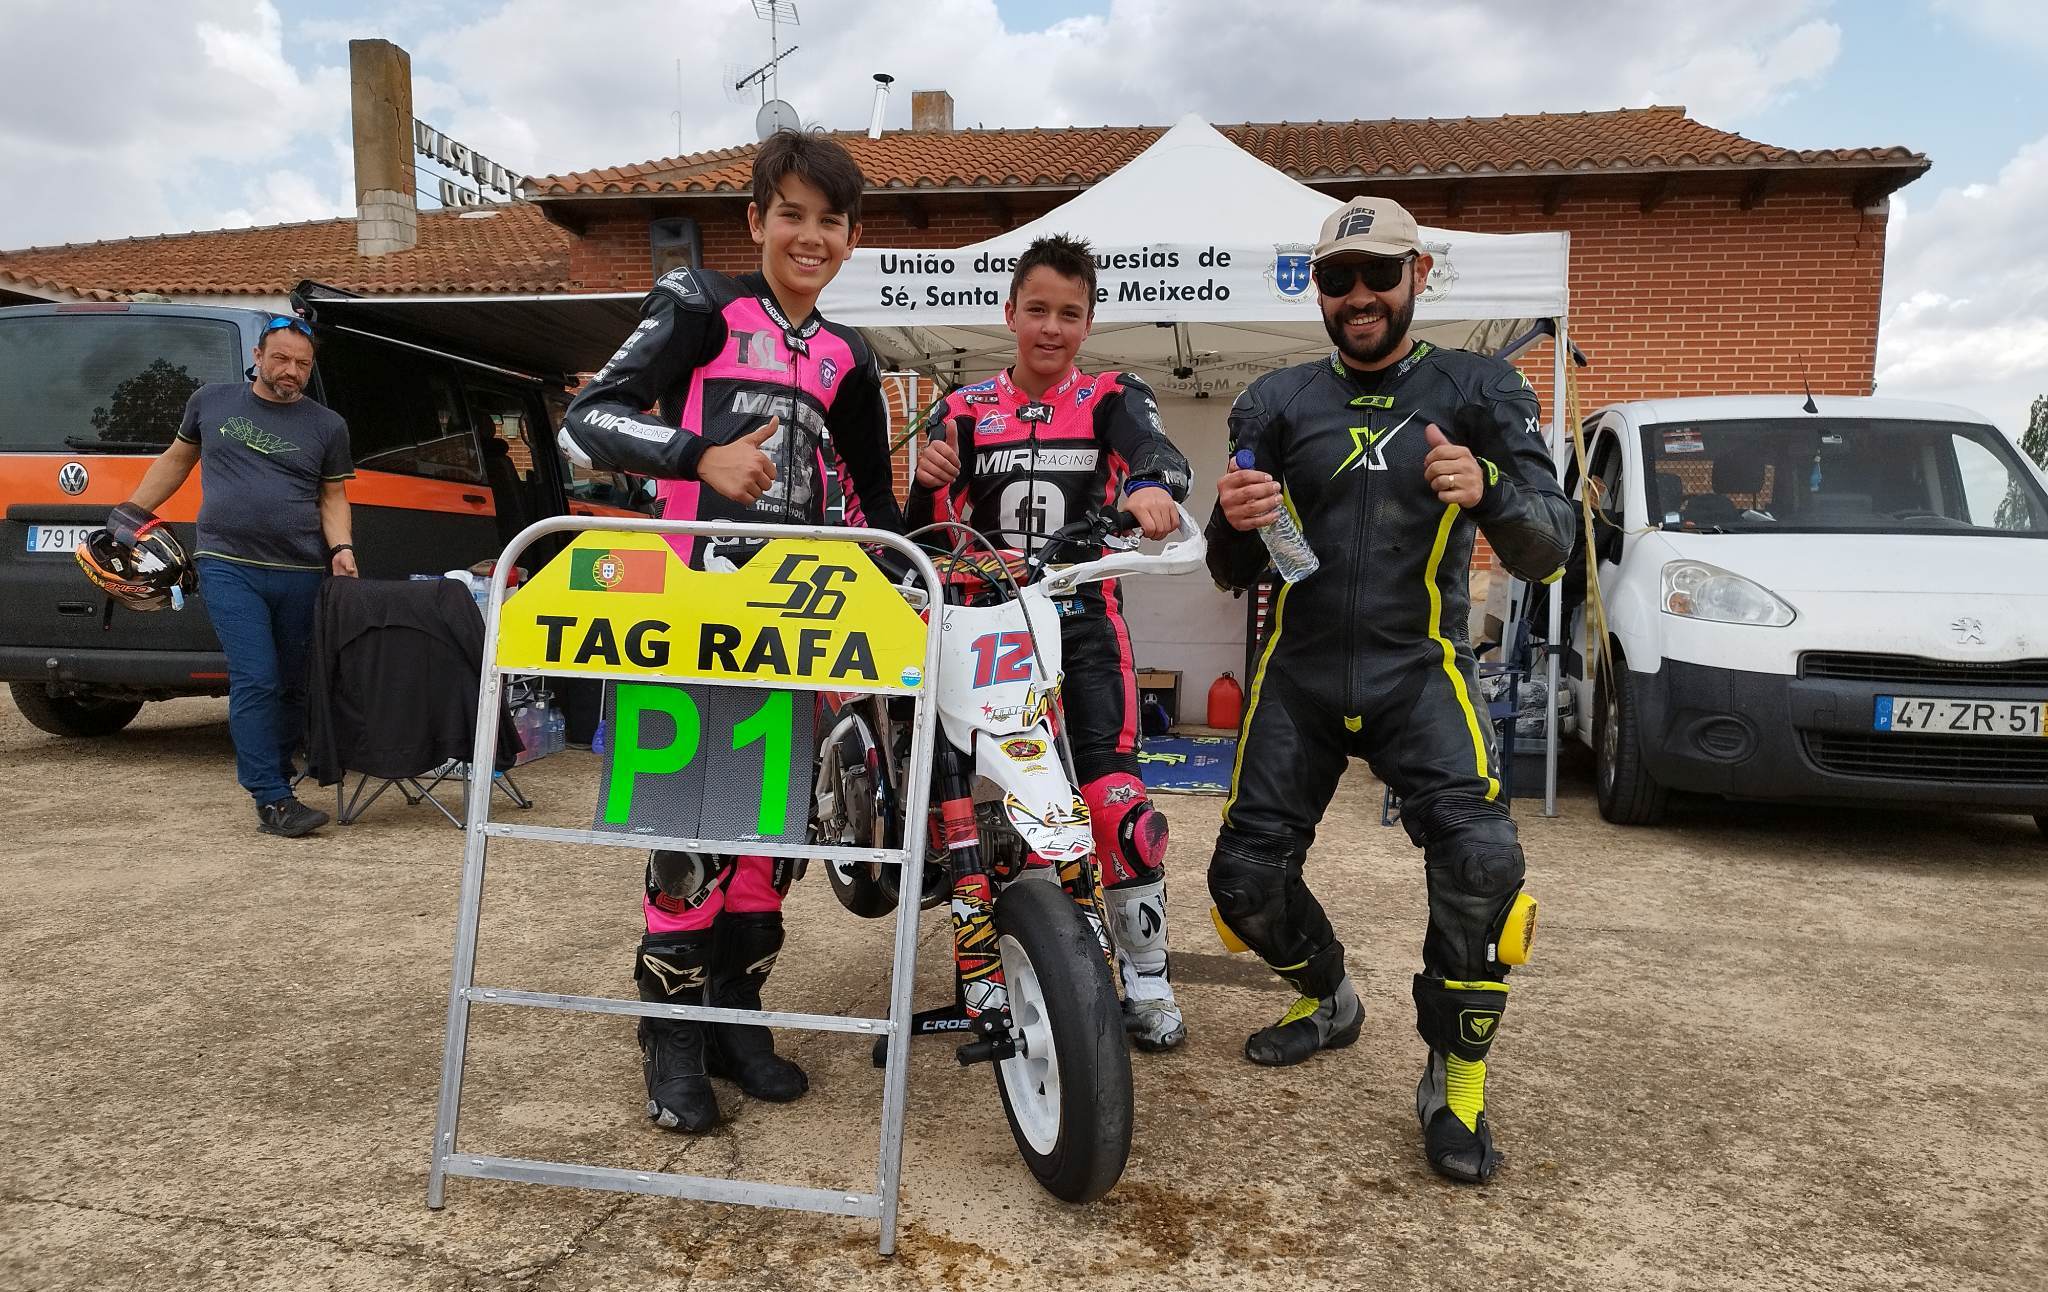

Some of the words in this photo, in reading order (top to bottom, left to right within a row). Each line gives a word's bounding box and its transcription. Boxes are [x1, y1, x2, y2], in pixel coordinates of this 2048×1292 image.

[1334, 214, 1375, 241] 12
[880, 252, 956, 275] União
[973, 252, 1017, 273] das
[1097, 248, 1180, 269] uesias
[1199, 246, 1232, 268] de
[880, 284, 917, 311] Sé,
[925, 285, 999, 307] Santa
[1118, 279, 1231, 302] Meixedo
[731, 391, 794, 420] MIR
[627, 423, 670, 440] RACING
[975, 450, 1031, 475] MIR
[1037, 453, 1095, 466] RACING
[746, 553, 859, 620] 56
[536, 615, 671, 668] TAG
[697, 623, 880, 681] RAFA
[970, 630, 1034, 690] 12
[1880, 716, 1888, 725] P
[922, 1019, 972, 1030] CROS
